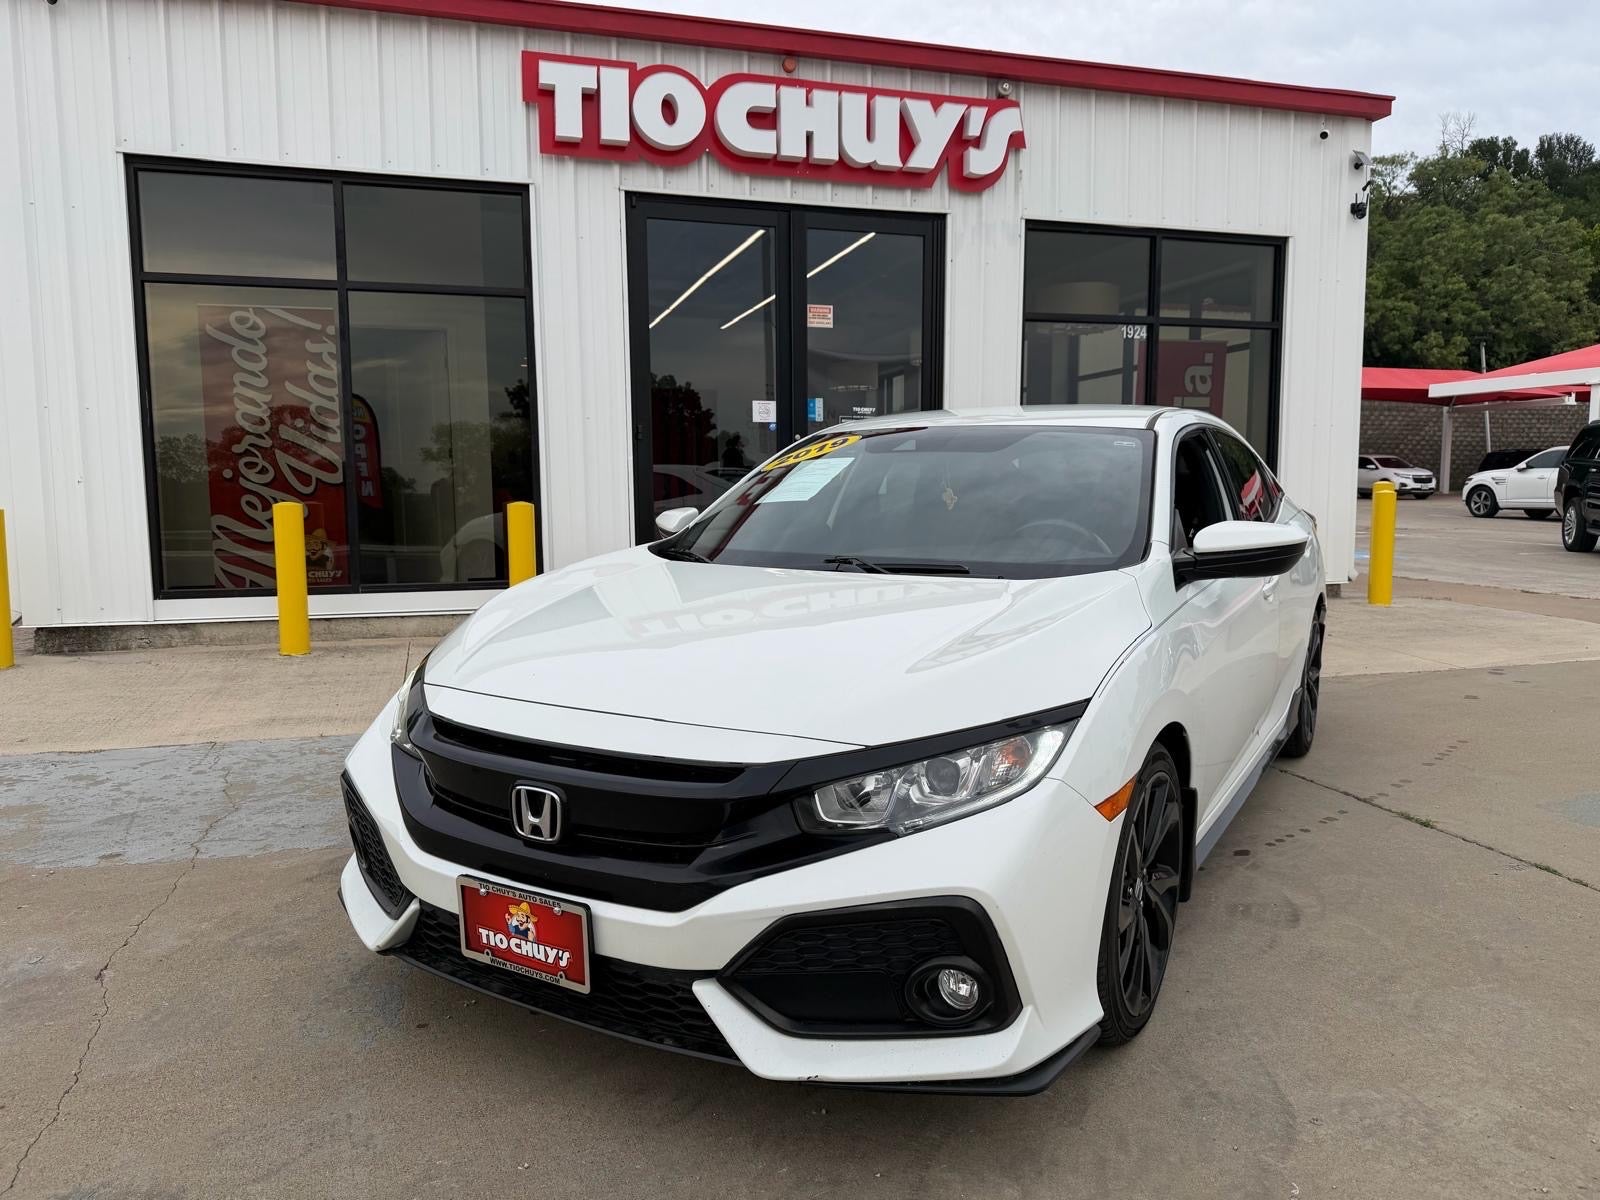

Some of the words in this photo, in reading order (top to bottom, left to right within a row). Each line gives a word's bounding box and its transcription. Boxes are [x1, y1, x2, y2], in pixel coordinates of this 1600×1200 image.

[537, 59, 707, 151] TIO
[714, 81, 1022, 180] CHUY'S
[1121, 325, 1147, 339] 1924
[777, 438, 849, 463] 2019
[478, 882, 490, 891] TIO
[491, 886, 517, 898] CHUY'S
[518, 892, 538, 903] AUTO
[539, 896, 562, 909] SALES
[478, 927, 508, 949] TIO
[509, 937, 570, 968] CHUY'S
[489, 957, 561, 985] WWW.TIOCHUYS.COM
